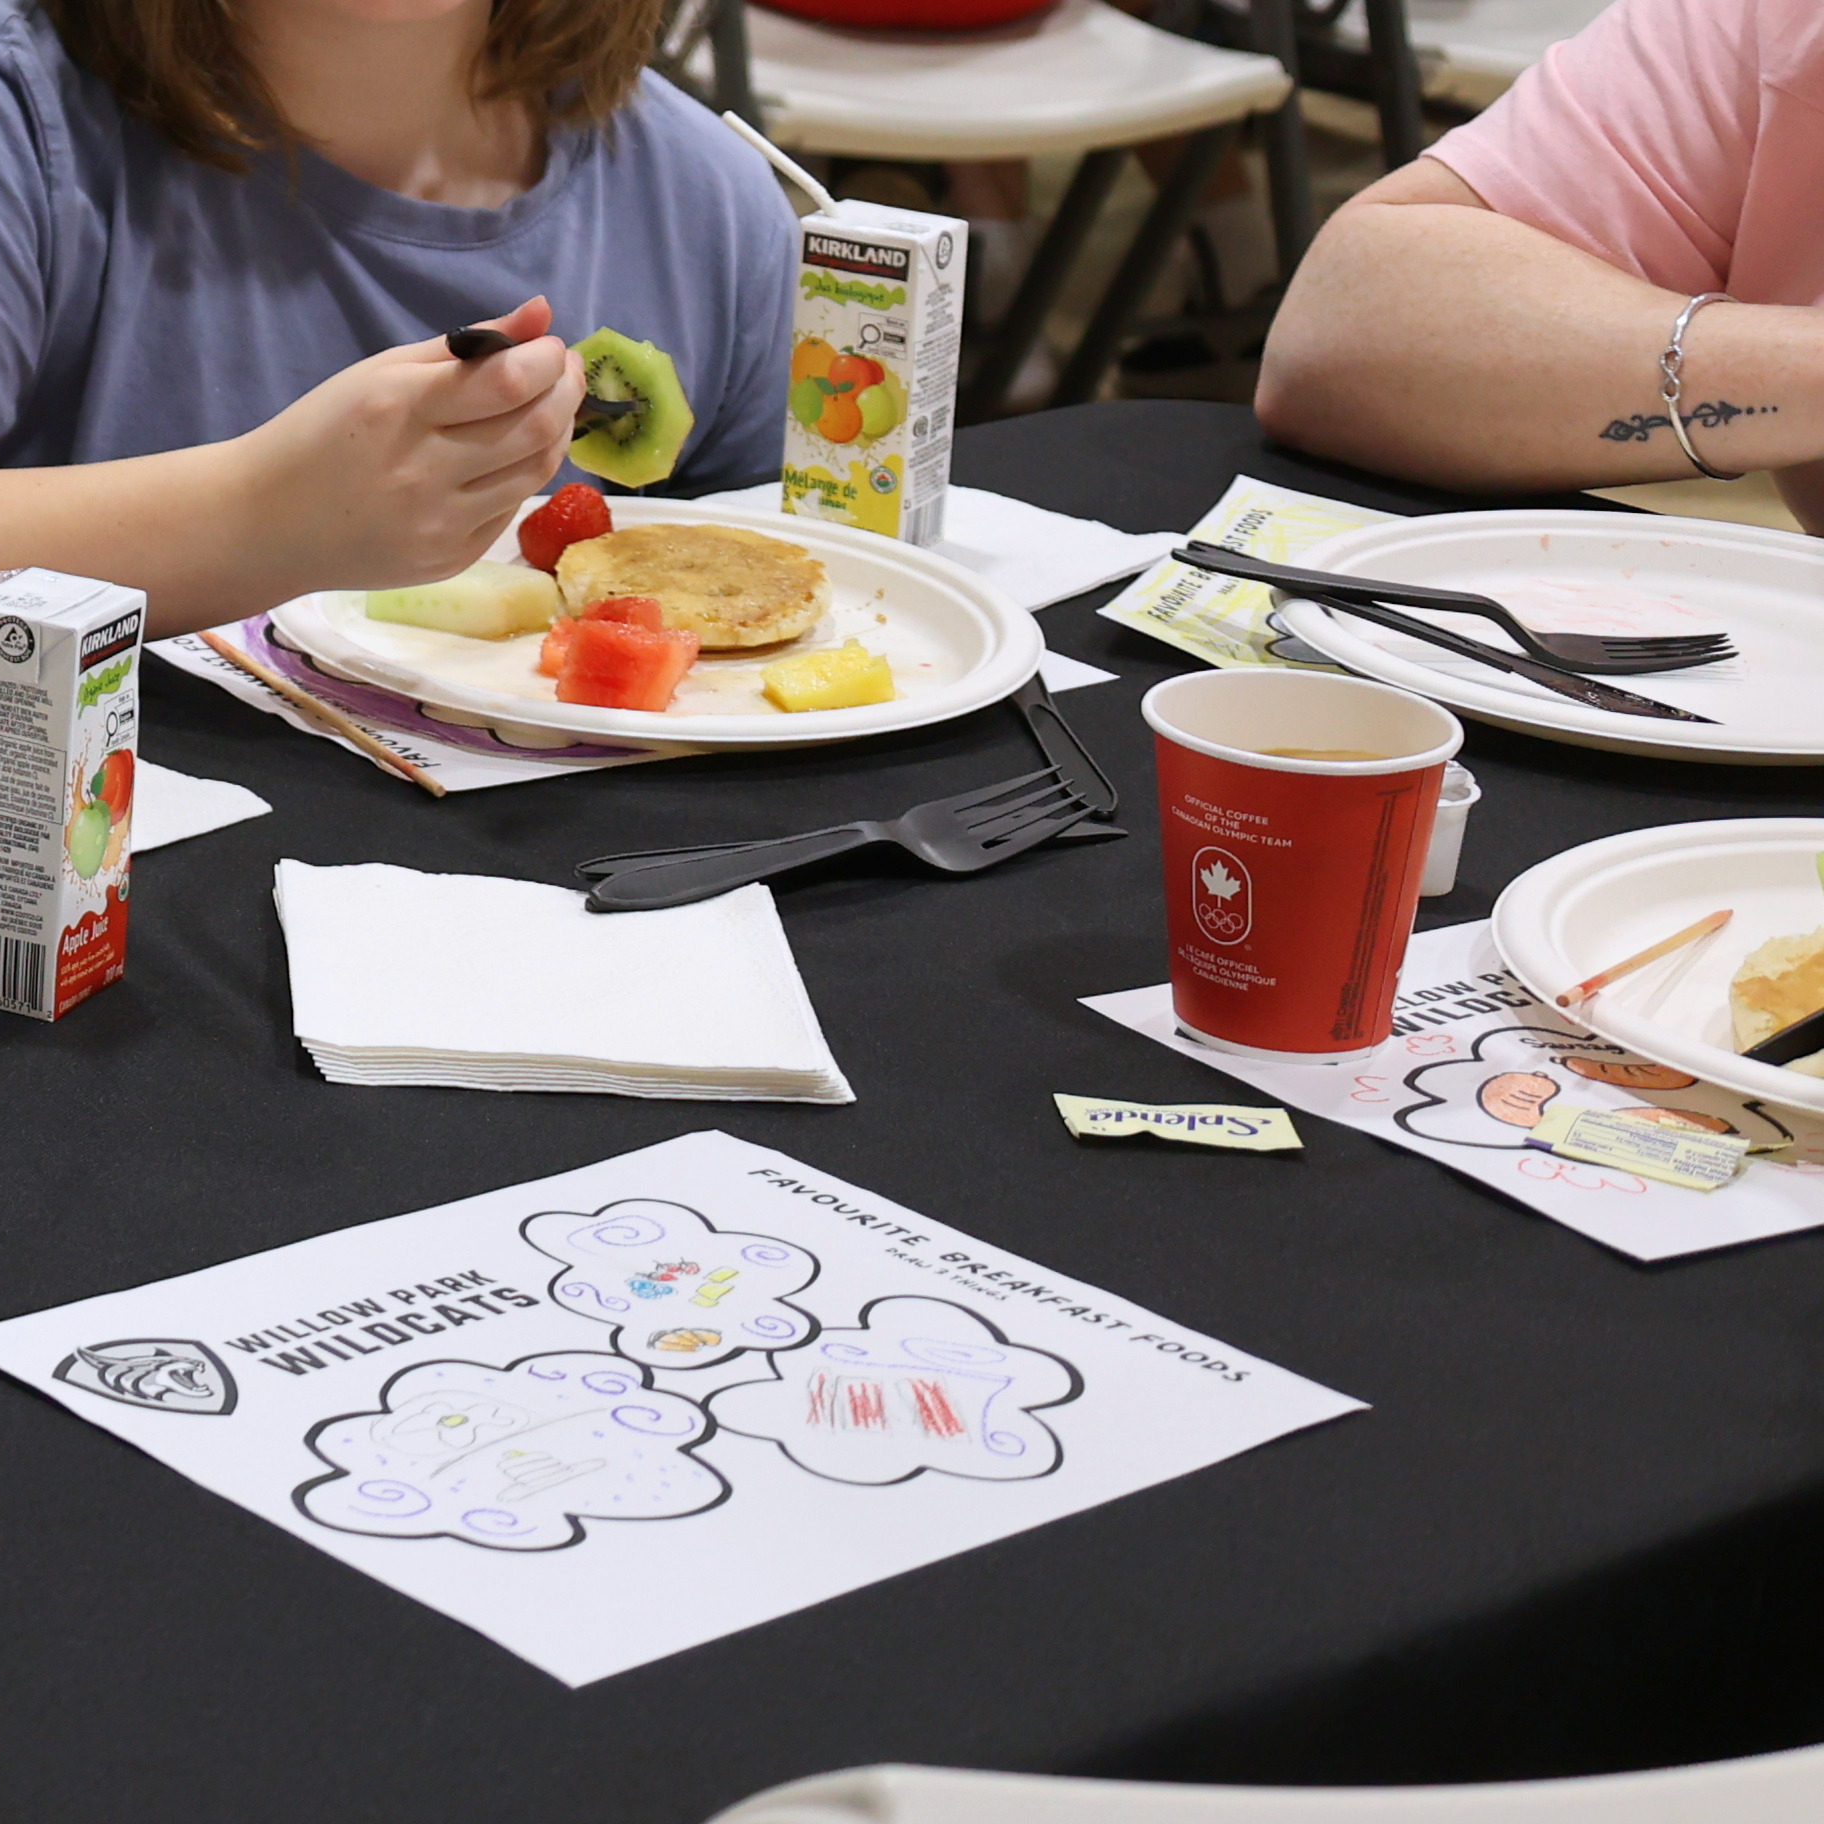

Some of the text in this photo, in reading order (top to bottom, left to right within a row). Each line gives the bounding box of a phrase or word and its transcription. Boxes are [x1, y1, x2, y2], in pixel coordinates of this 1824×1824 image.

[808, 236, 907, 268] KIRKLAND
[1147, 578, 1197, 623] FAVOURITE
[1239, 508, 1274, 537] FOODS
[81, 614, 139, 658] KIRKLAND
[1170, 805, 1292, 848] CANADIAN OLYMPIC TEAM
[1184, 794, 1269, 826] OFFICIAL COFFEE
[1204, 812, 1240, 830] OF THE
[62, 916, 109, 956] Apple Juice
[1192, 965, 1249, 992] CANADIENNE
[1217, 955, 1259, 975] OFFICIEL
[1218, 966, 1276, 987] OLYMPIQUE
[1395, 980, 1478, 1012] LOW
[1089, 1111, 1272, 1136] Splenda
[748, 1168, 1251, 1385] FAVOURITE BREAKFAST FOODS
[885, 1246, 933, 1271] DRAW
[949, 1274, 1011, 1302] THINGS
[224, 1269, 498, 1354] WILLOW PARK
[259, 1287, 540, 1376] WILDCATS
